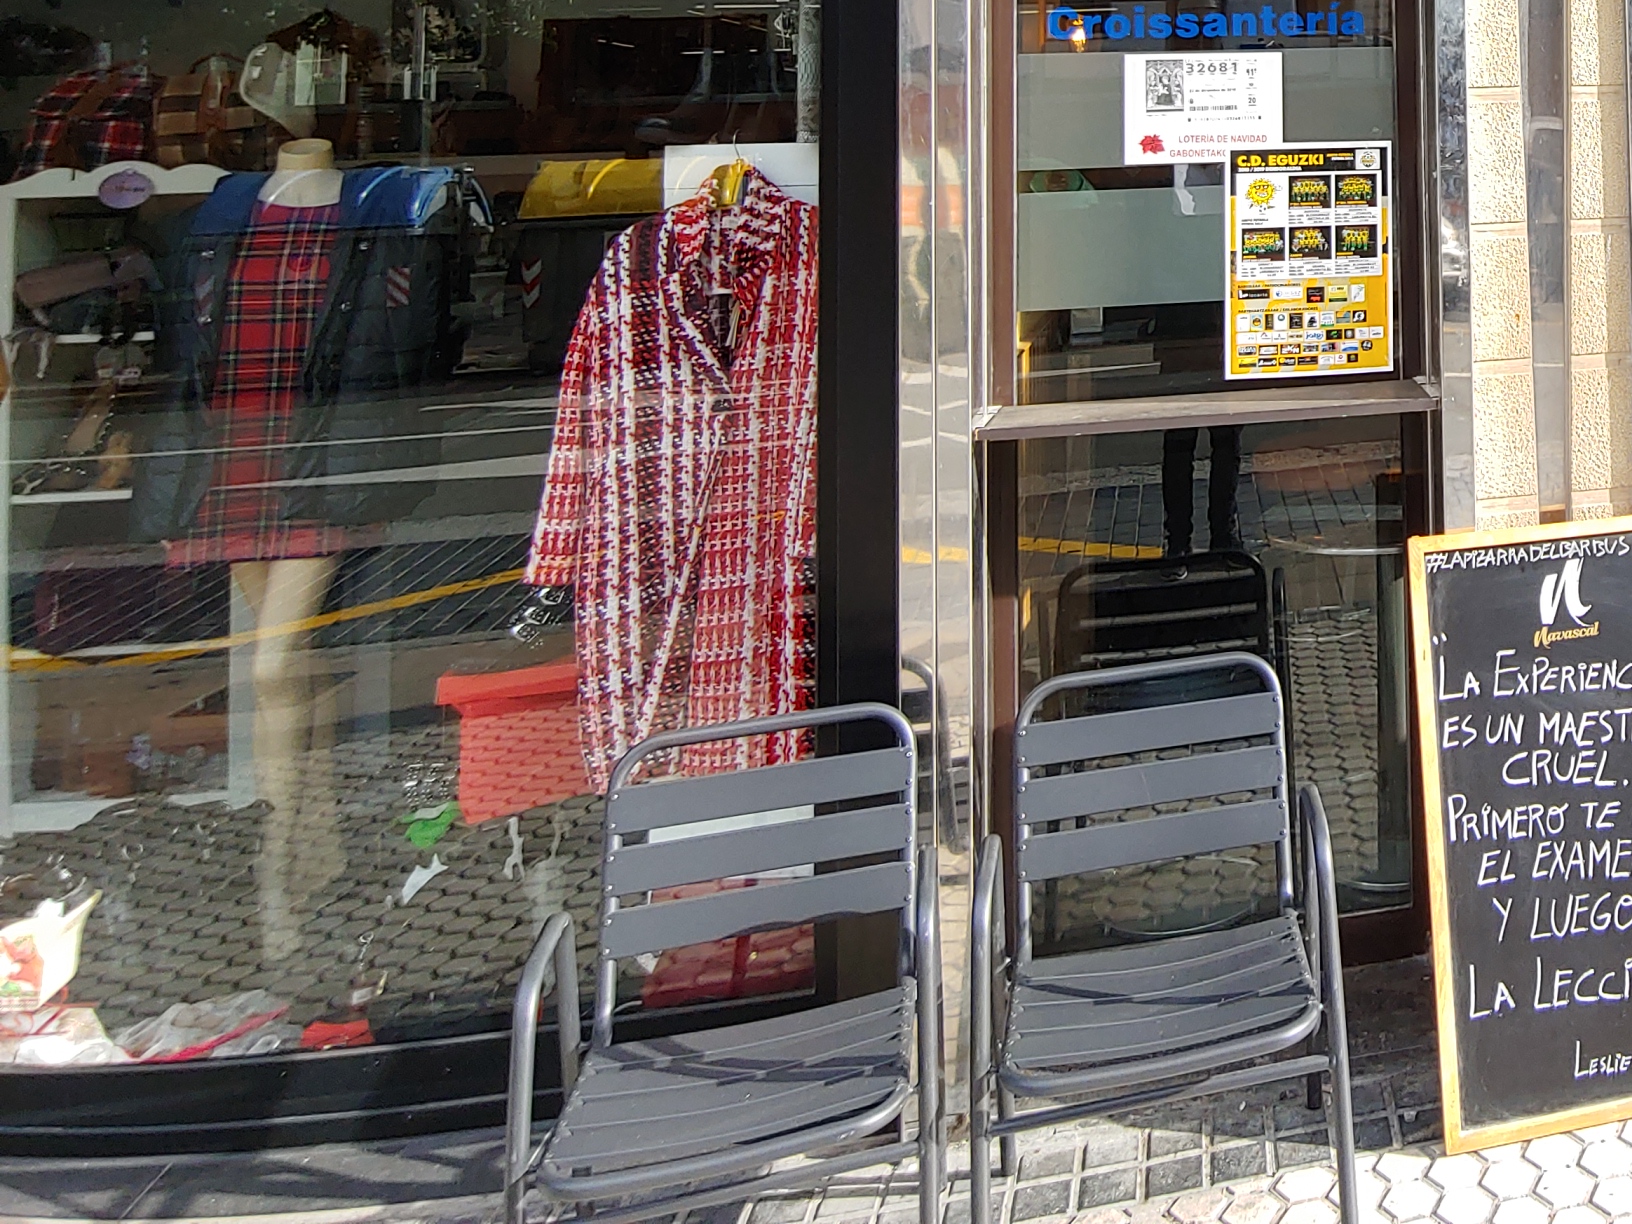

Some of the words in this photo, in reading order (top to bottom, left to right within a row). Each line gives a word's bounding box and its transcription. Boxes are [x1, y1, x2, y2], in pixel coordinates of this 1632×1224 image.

[1047, 1, 1366, 41] Croissantería
[1185, 62, 1238, 73] 32681
[1178, 133, 1216, 143] LOTERÍA
[1217, 134, 1228, 143] DE
[1230, 134, 1268, 143] NAVIDAD
[1236, 155, 1266, 167] C.D.
[1268, 153, 1325, 166] EGUZKI
[1442, 714, 1478, 750] ES
[1485, 712, 1525, 747] UN
[1501, 749, 1630, 790] CRUEL.
[1447, 793, 1570, 844] PRIMERO
[1580, 800, 1622, 829] TE
[1477, 849, 1516, 887] EL
[1492, 897, 1513, 944] Y
[1469, 963, 1516, 1021] LA
